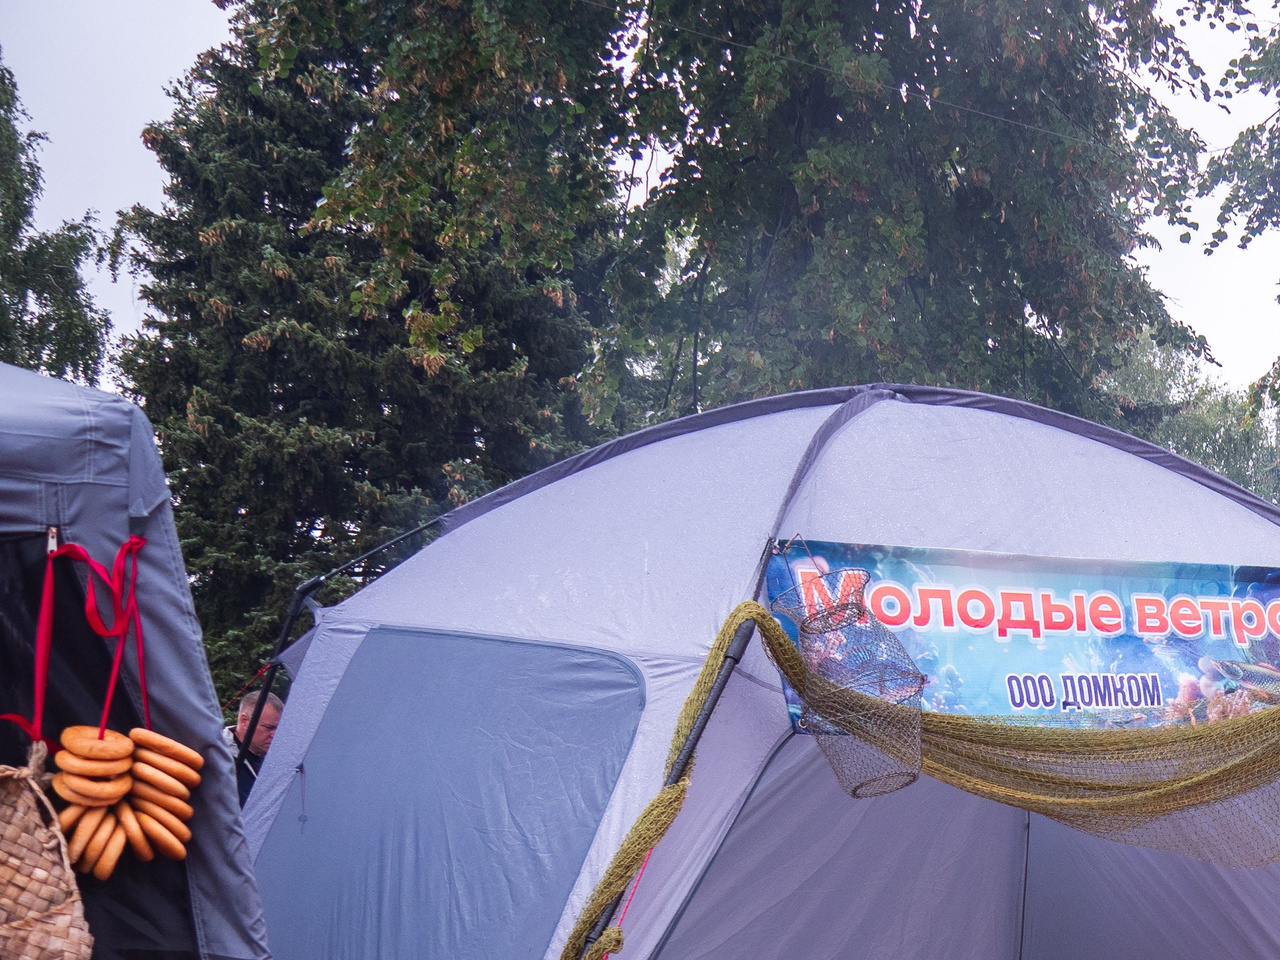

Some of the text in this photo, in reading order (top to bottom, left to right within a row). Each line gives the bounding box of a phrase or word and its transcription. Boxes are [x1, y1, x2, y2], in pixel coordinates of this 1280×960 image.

[798, 570, 1122, 638] Молодые
[1008, 674, 1162, 711] ООО ДОМКОМ
